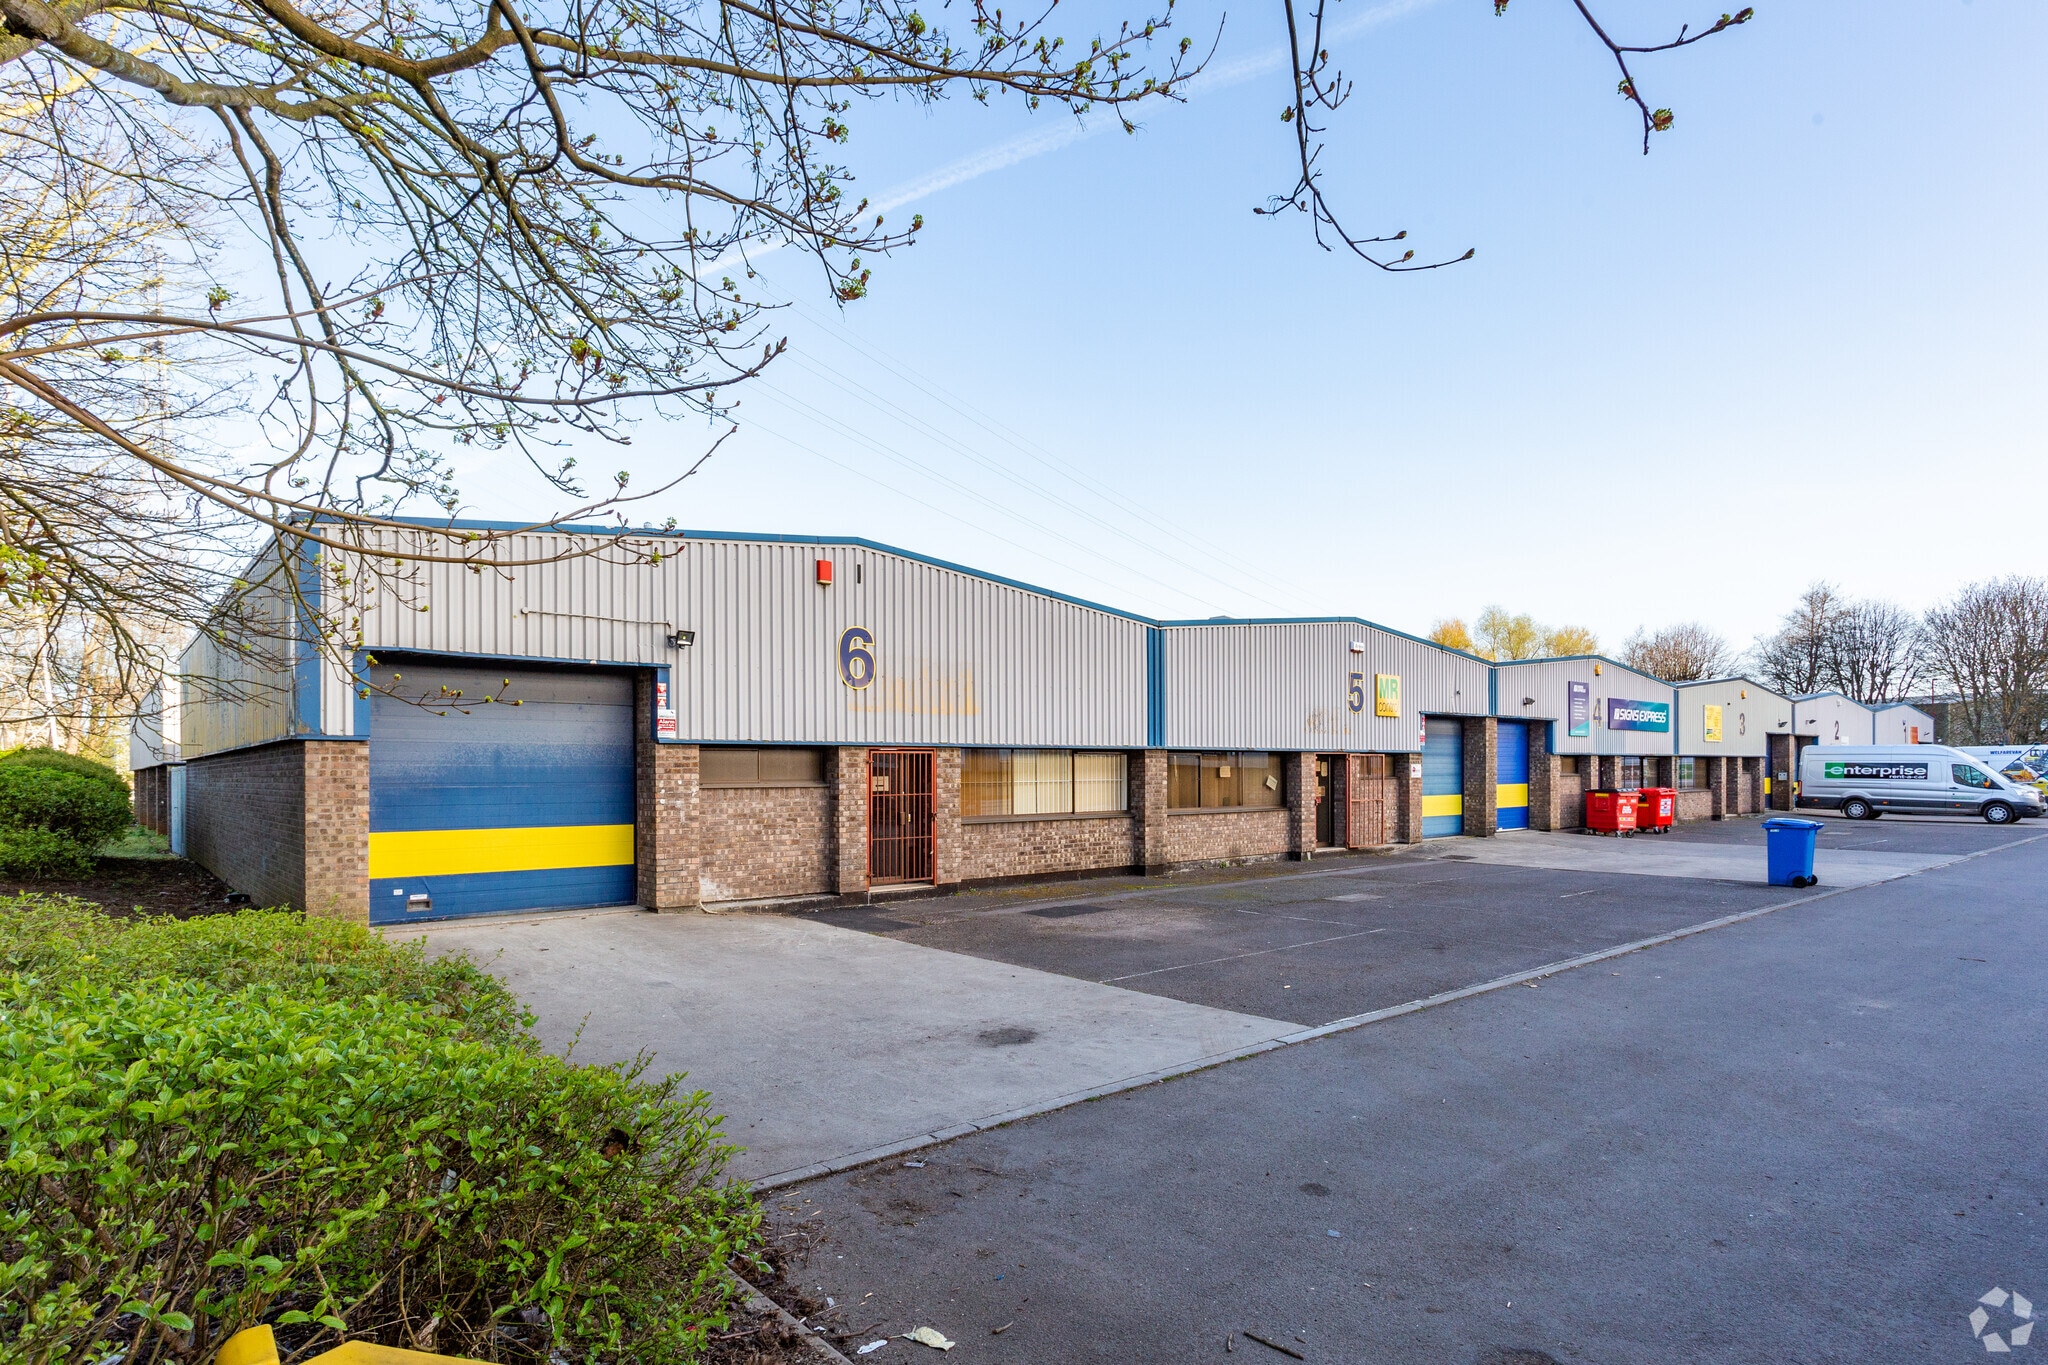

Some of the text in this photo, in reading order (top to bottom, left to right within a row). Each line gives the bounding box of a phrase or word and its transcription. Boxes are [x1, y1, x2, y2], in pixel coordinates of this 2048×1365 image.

[838, 625, 877, 690] 6
[1348, 671, 1364, 714] 5
[1379, 677, 1399, 699] MR
[1593, 697, 1602, 729] 4
[1619, 708, 1667, 723] SIGNS EXPRESS
[1739, 712, 1746, 736] 3
[1834, 720, 1840, 740] 2
[1829, 765, 1927, 777] enterprise
